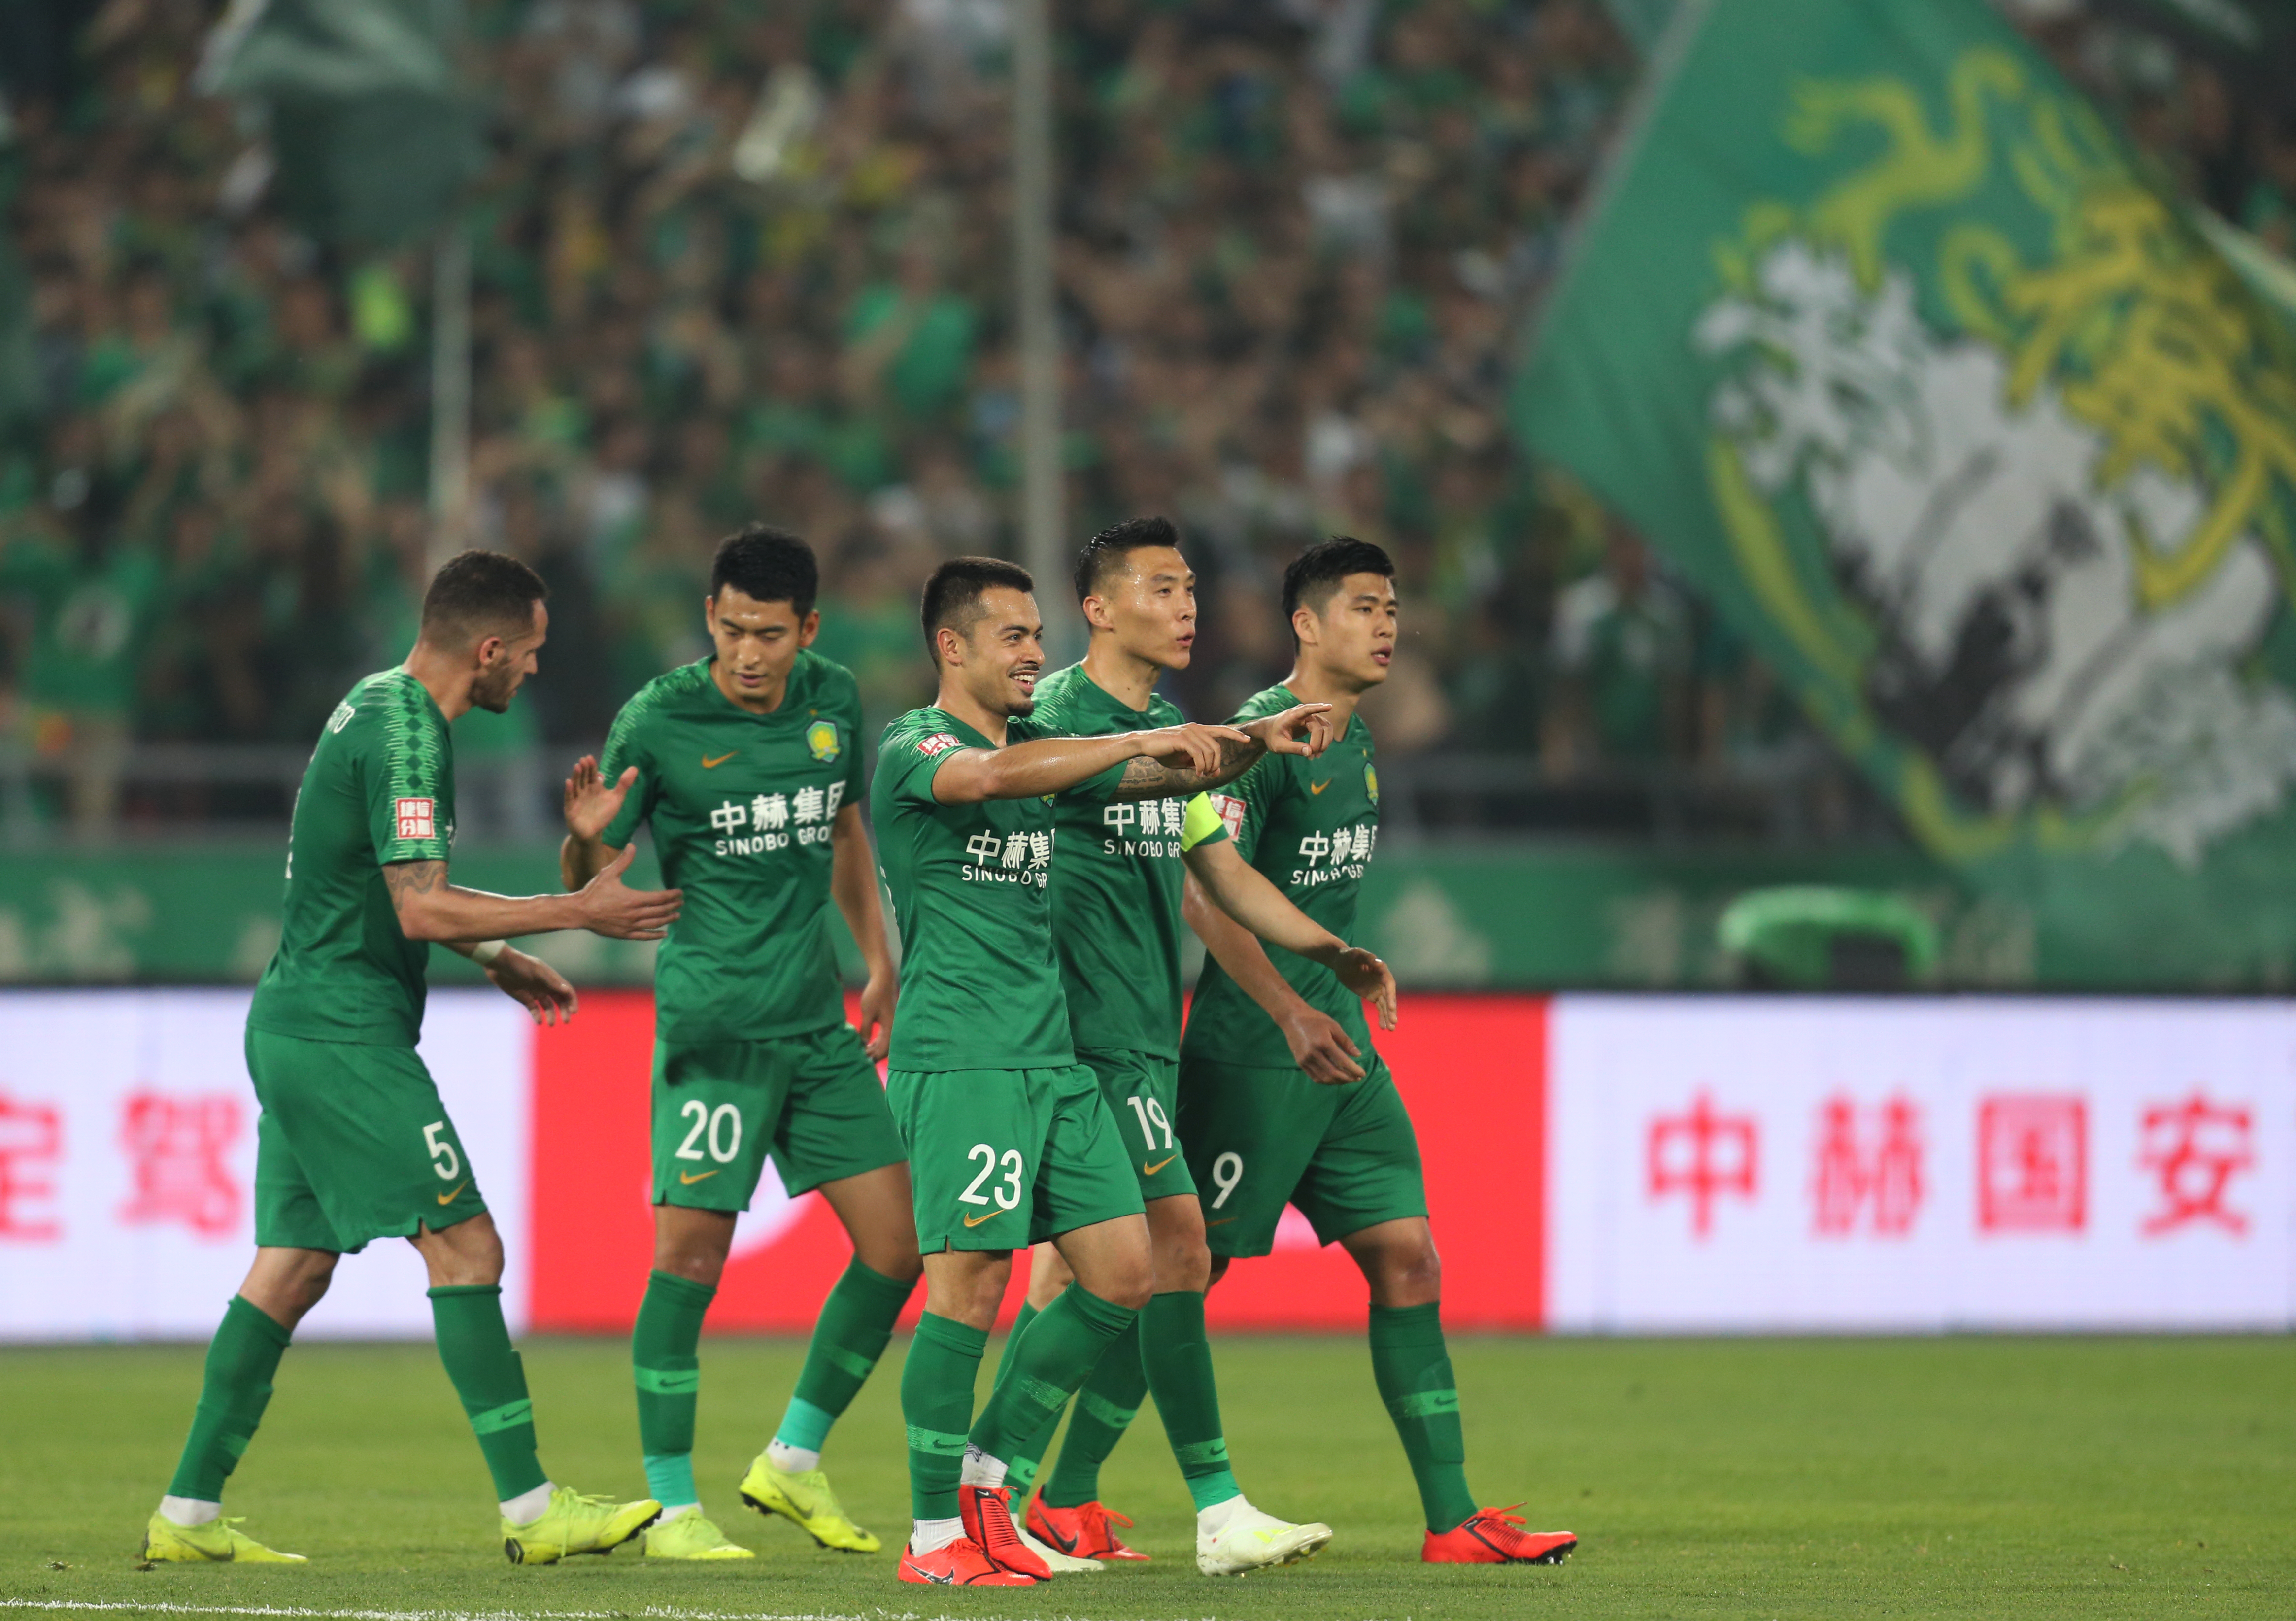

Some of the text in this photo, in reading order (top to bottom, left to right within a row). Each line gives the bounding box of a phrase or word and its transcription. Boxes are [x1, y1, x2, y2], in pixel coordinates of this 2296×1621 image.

[715, 825, 834, 856] SINOBO GRO
[965, 828, 1055, 870] 中赫集
[1104, 839, 1163, 858] SINOBO
[962, 865, 1032, 885] SINOBO
[422, 1121, 460, 1180] 5
[675, 1100, 742, 1163] 20
[1127, 1096, 1172, 1151] 19
[958, 1144, 1022, 1210] 23
[1212, 1152, 1243, 1210] 9
[1643, 1086, 2256, 1242] 中赫国安
